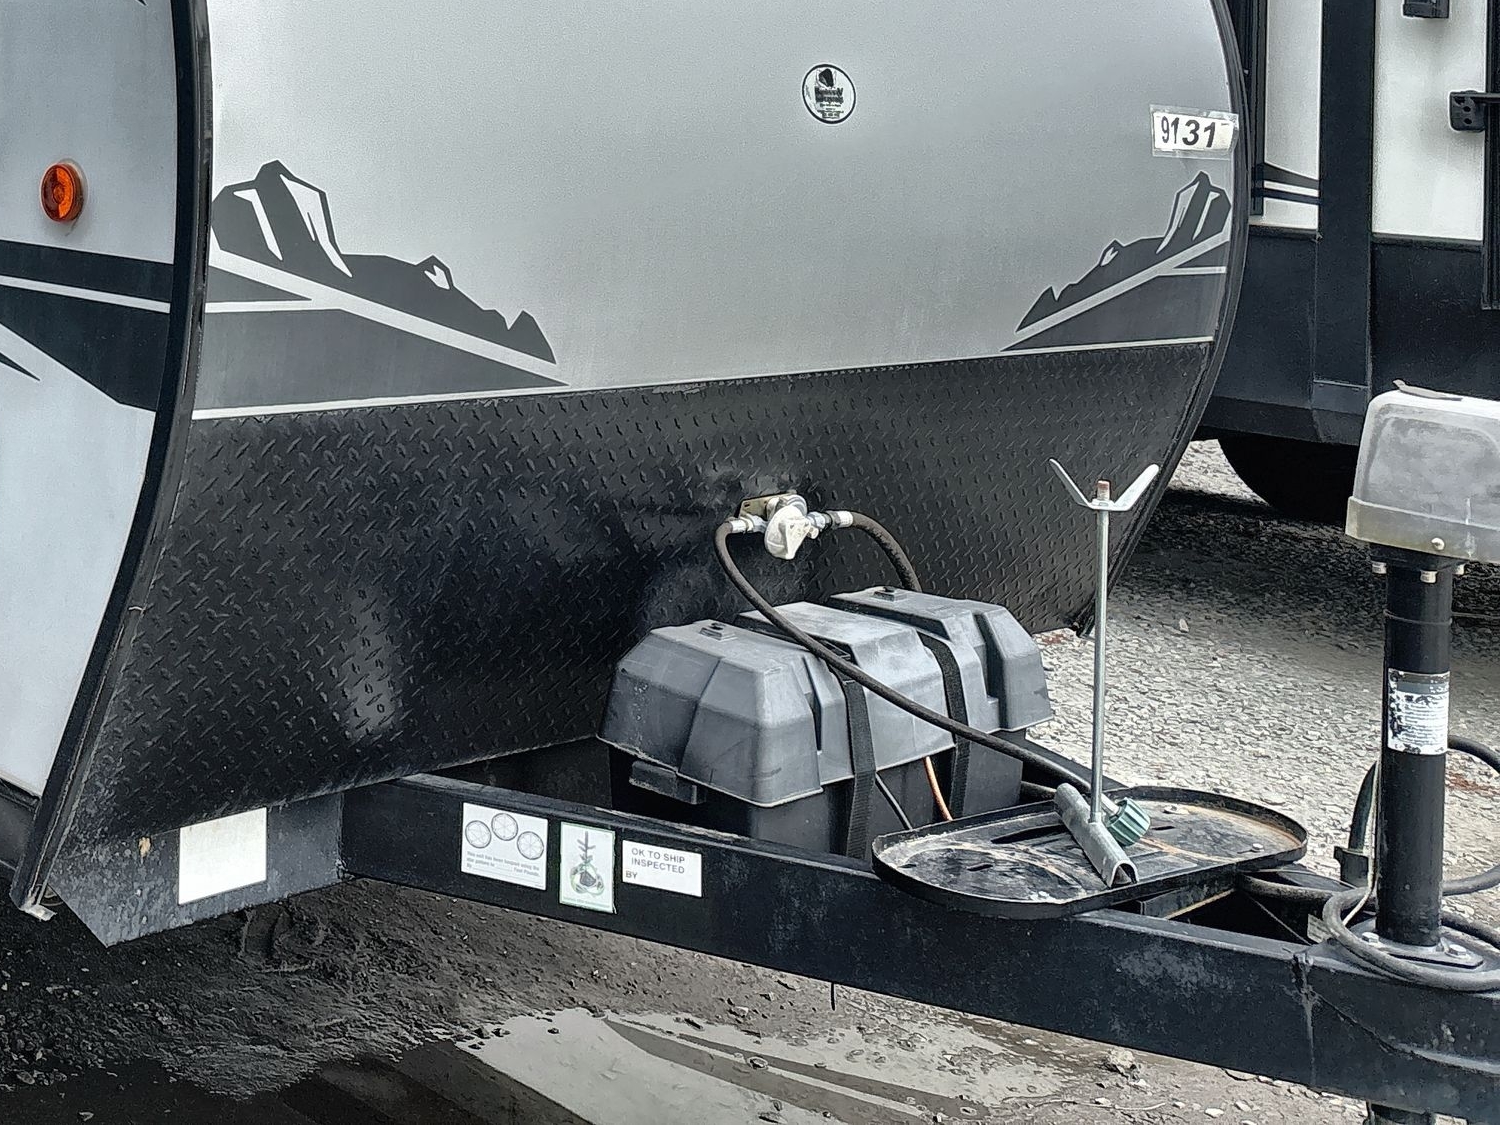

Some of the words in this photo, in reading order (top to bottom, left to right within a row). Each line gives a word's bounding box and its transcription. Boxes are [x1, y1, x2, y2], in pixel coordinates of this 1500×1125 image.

[1161, 115, 1216, 148] 9131
[631, 847, 645, 857] OK
[649, 851, 661, 860] TO
[663, 853, 685, 864] SHIP
[631, 857, 685, 874] INSPECTED
[625, 871, 638, 879] BY
